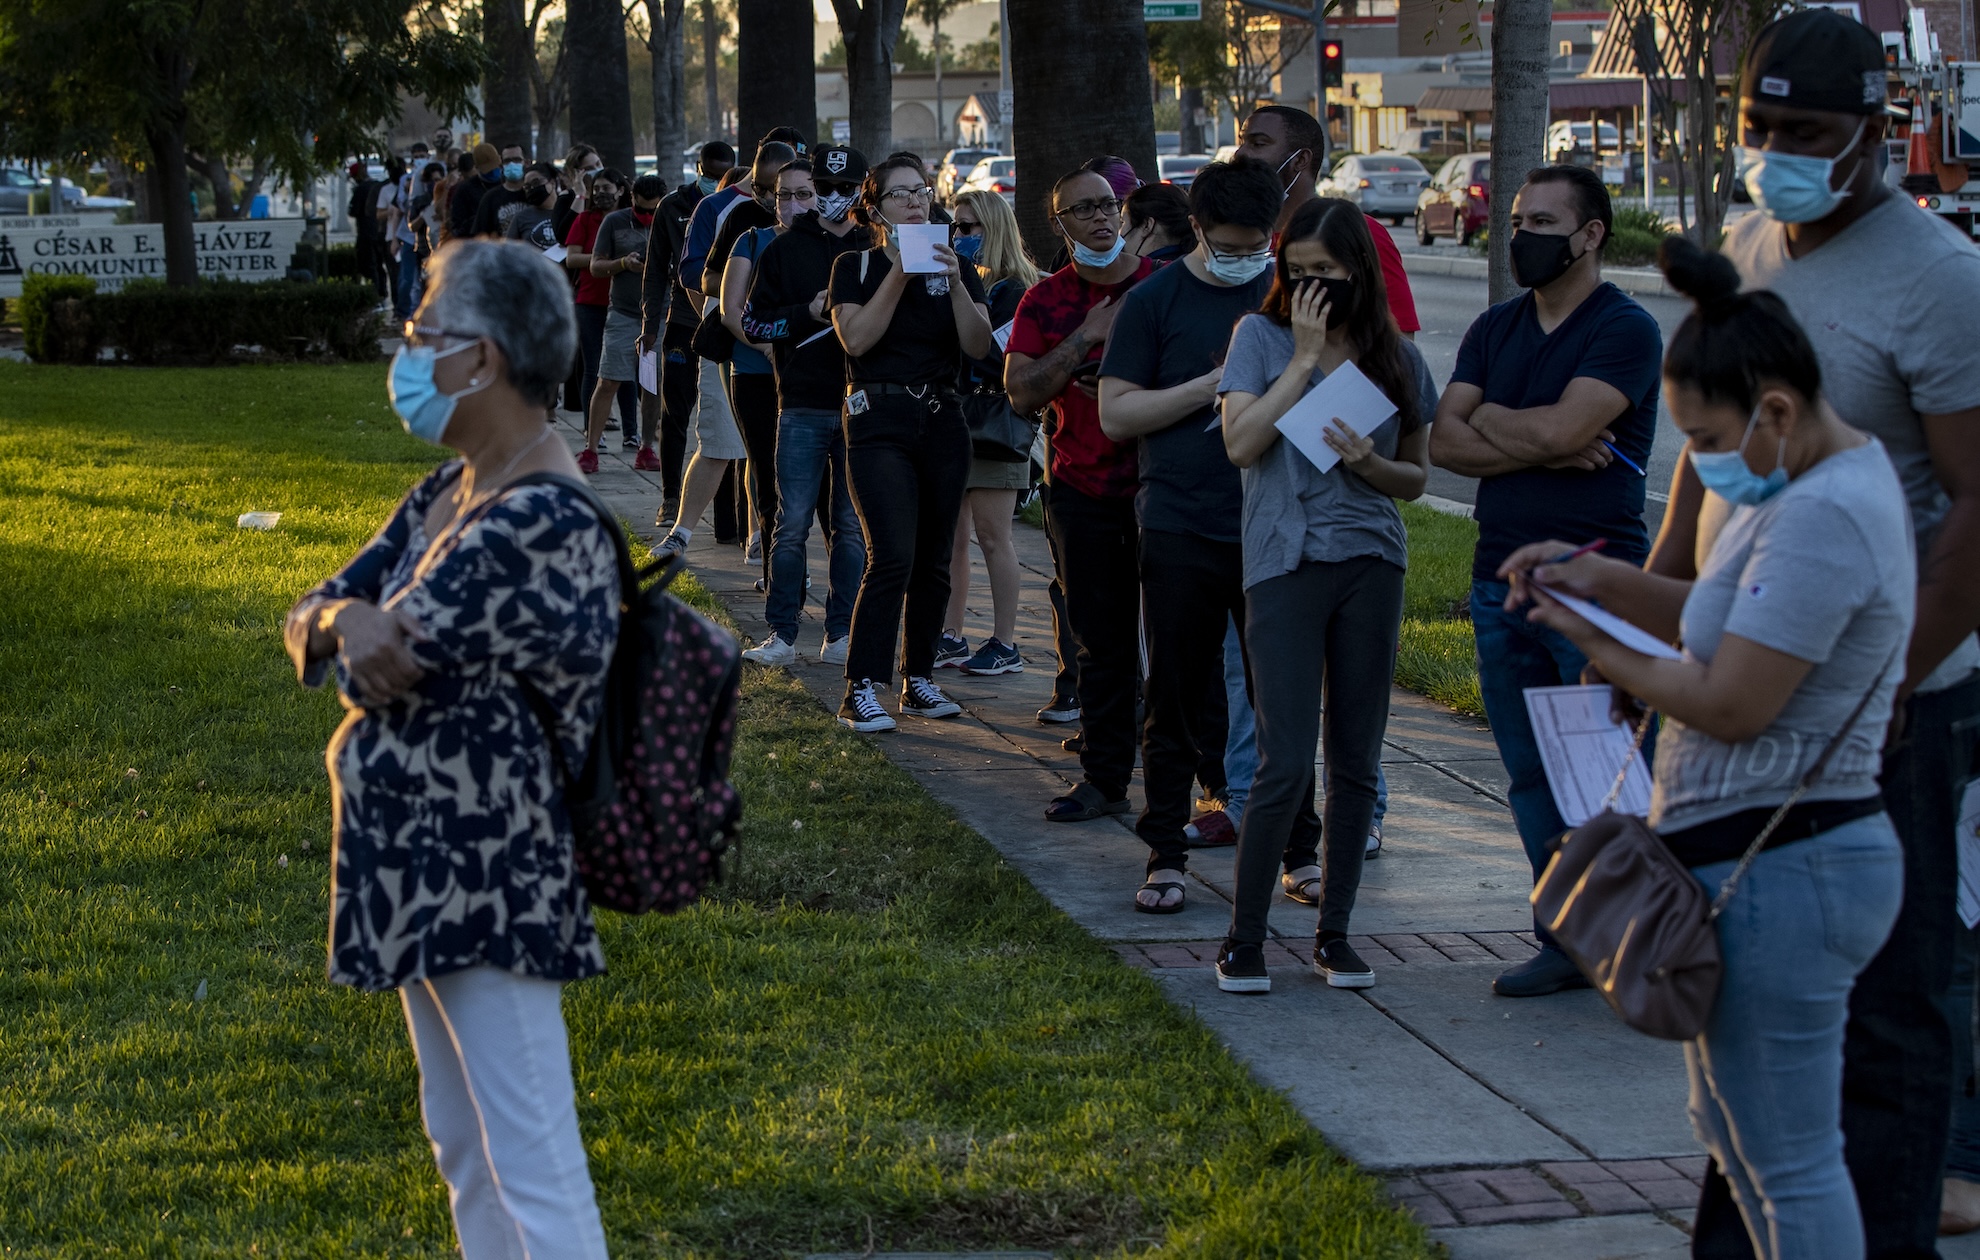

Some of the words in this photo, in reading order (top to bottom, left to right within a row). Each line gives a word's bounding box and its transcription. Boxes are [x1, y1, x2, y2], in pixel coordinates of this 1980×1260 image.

[34, 229, 115, 256] CÉSAR
[134, 234, 155, 253] E.
[194, 224, 272, 251] HÁVEZ
